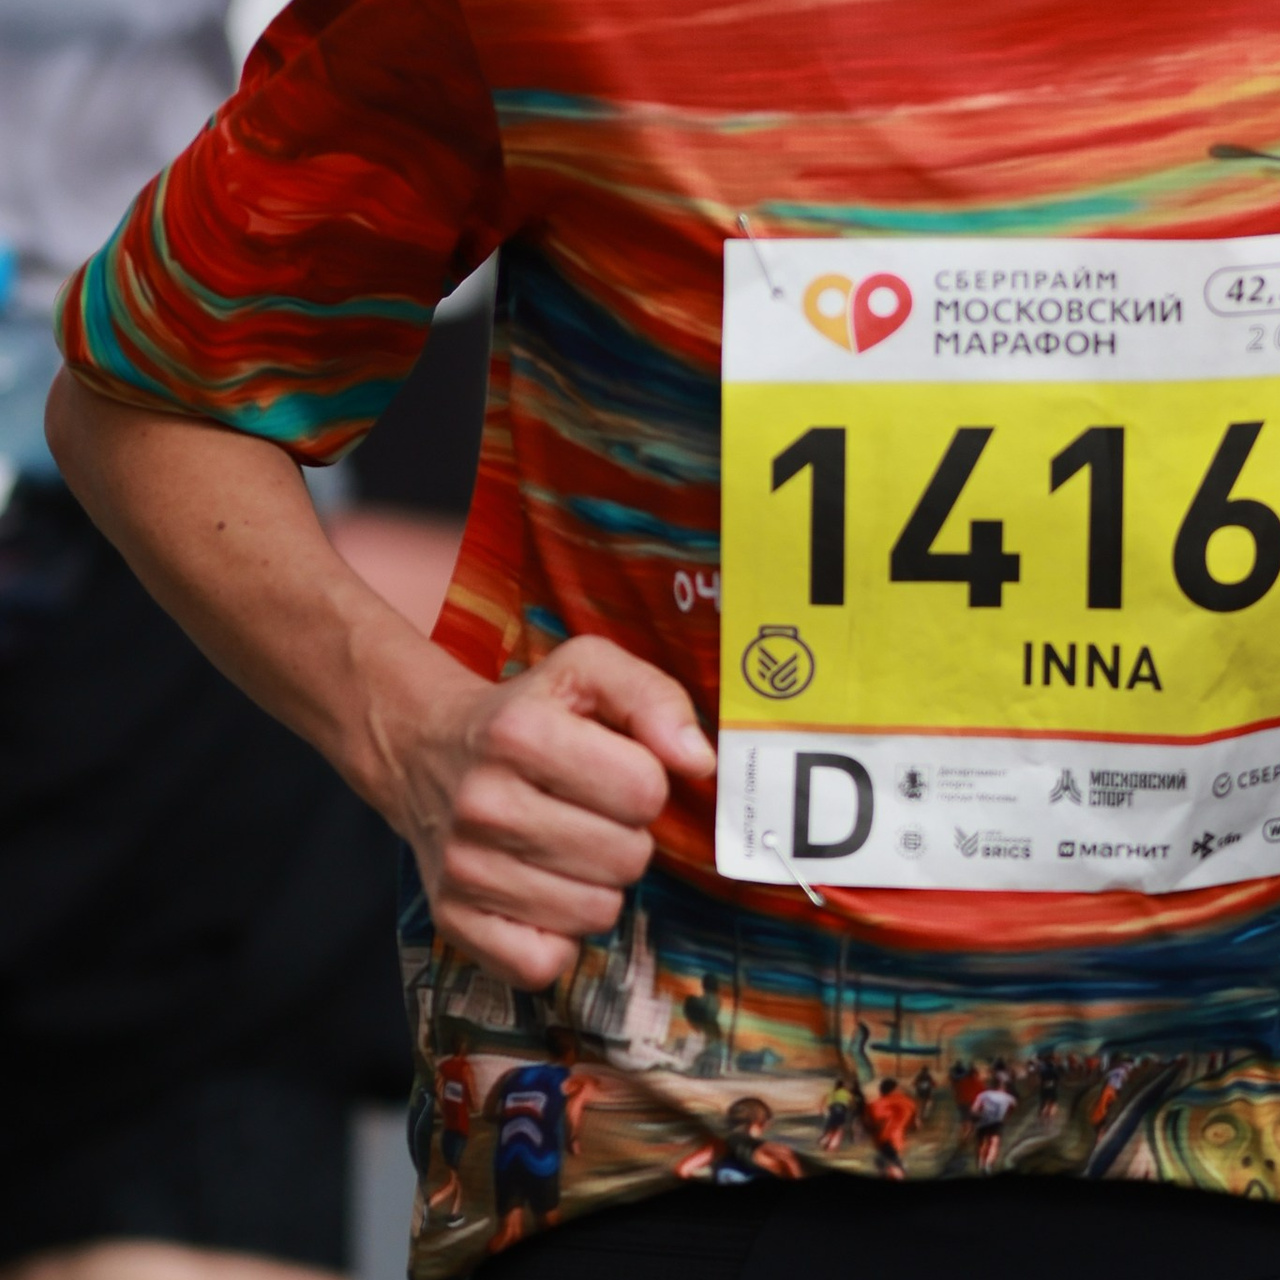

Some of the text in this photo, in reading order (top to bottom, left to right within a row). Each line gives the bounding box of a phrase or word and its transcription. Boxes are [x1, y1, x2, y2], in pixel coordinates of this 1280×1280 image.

[934, 265, 1118, 291] СБЕРПРАЙМ
[934, 292, 1183, 324] МОСКОВСКИЙ
[934, 329, 1117, 357] МАРАФОН
[1022, 641, 1163, 691] INNA
[1090, 769, 1188, 790] МОСКОВСКИЙ
[793, 751, 874, 858] D
[1089, 790, 1134, 807] СПОРТ
[982, 845, 1032, 859] BRICS
[1079, 843, 1171, 858] магнит
